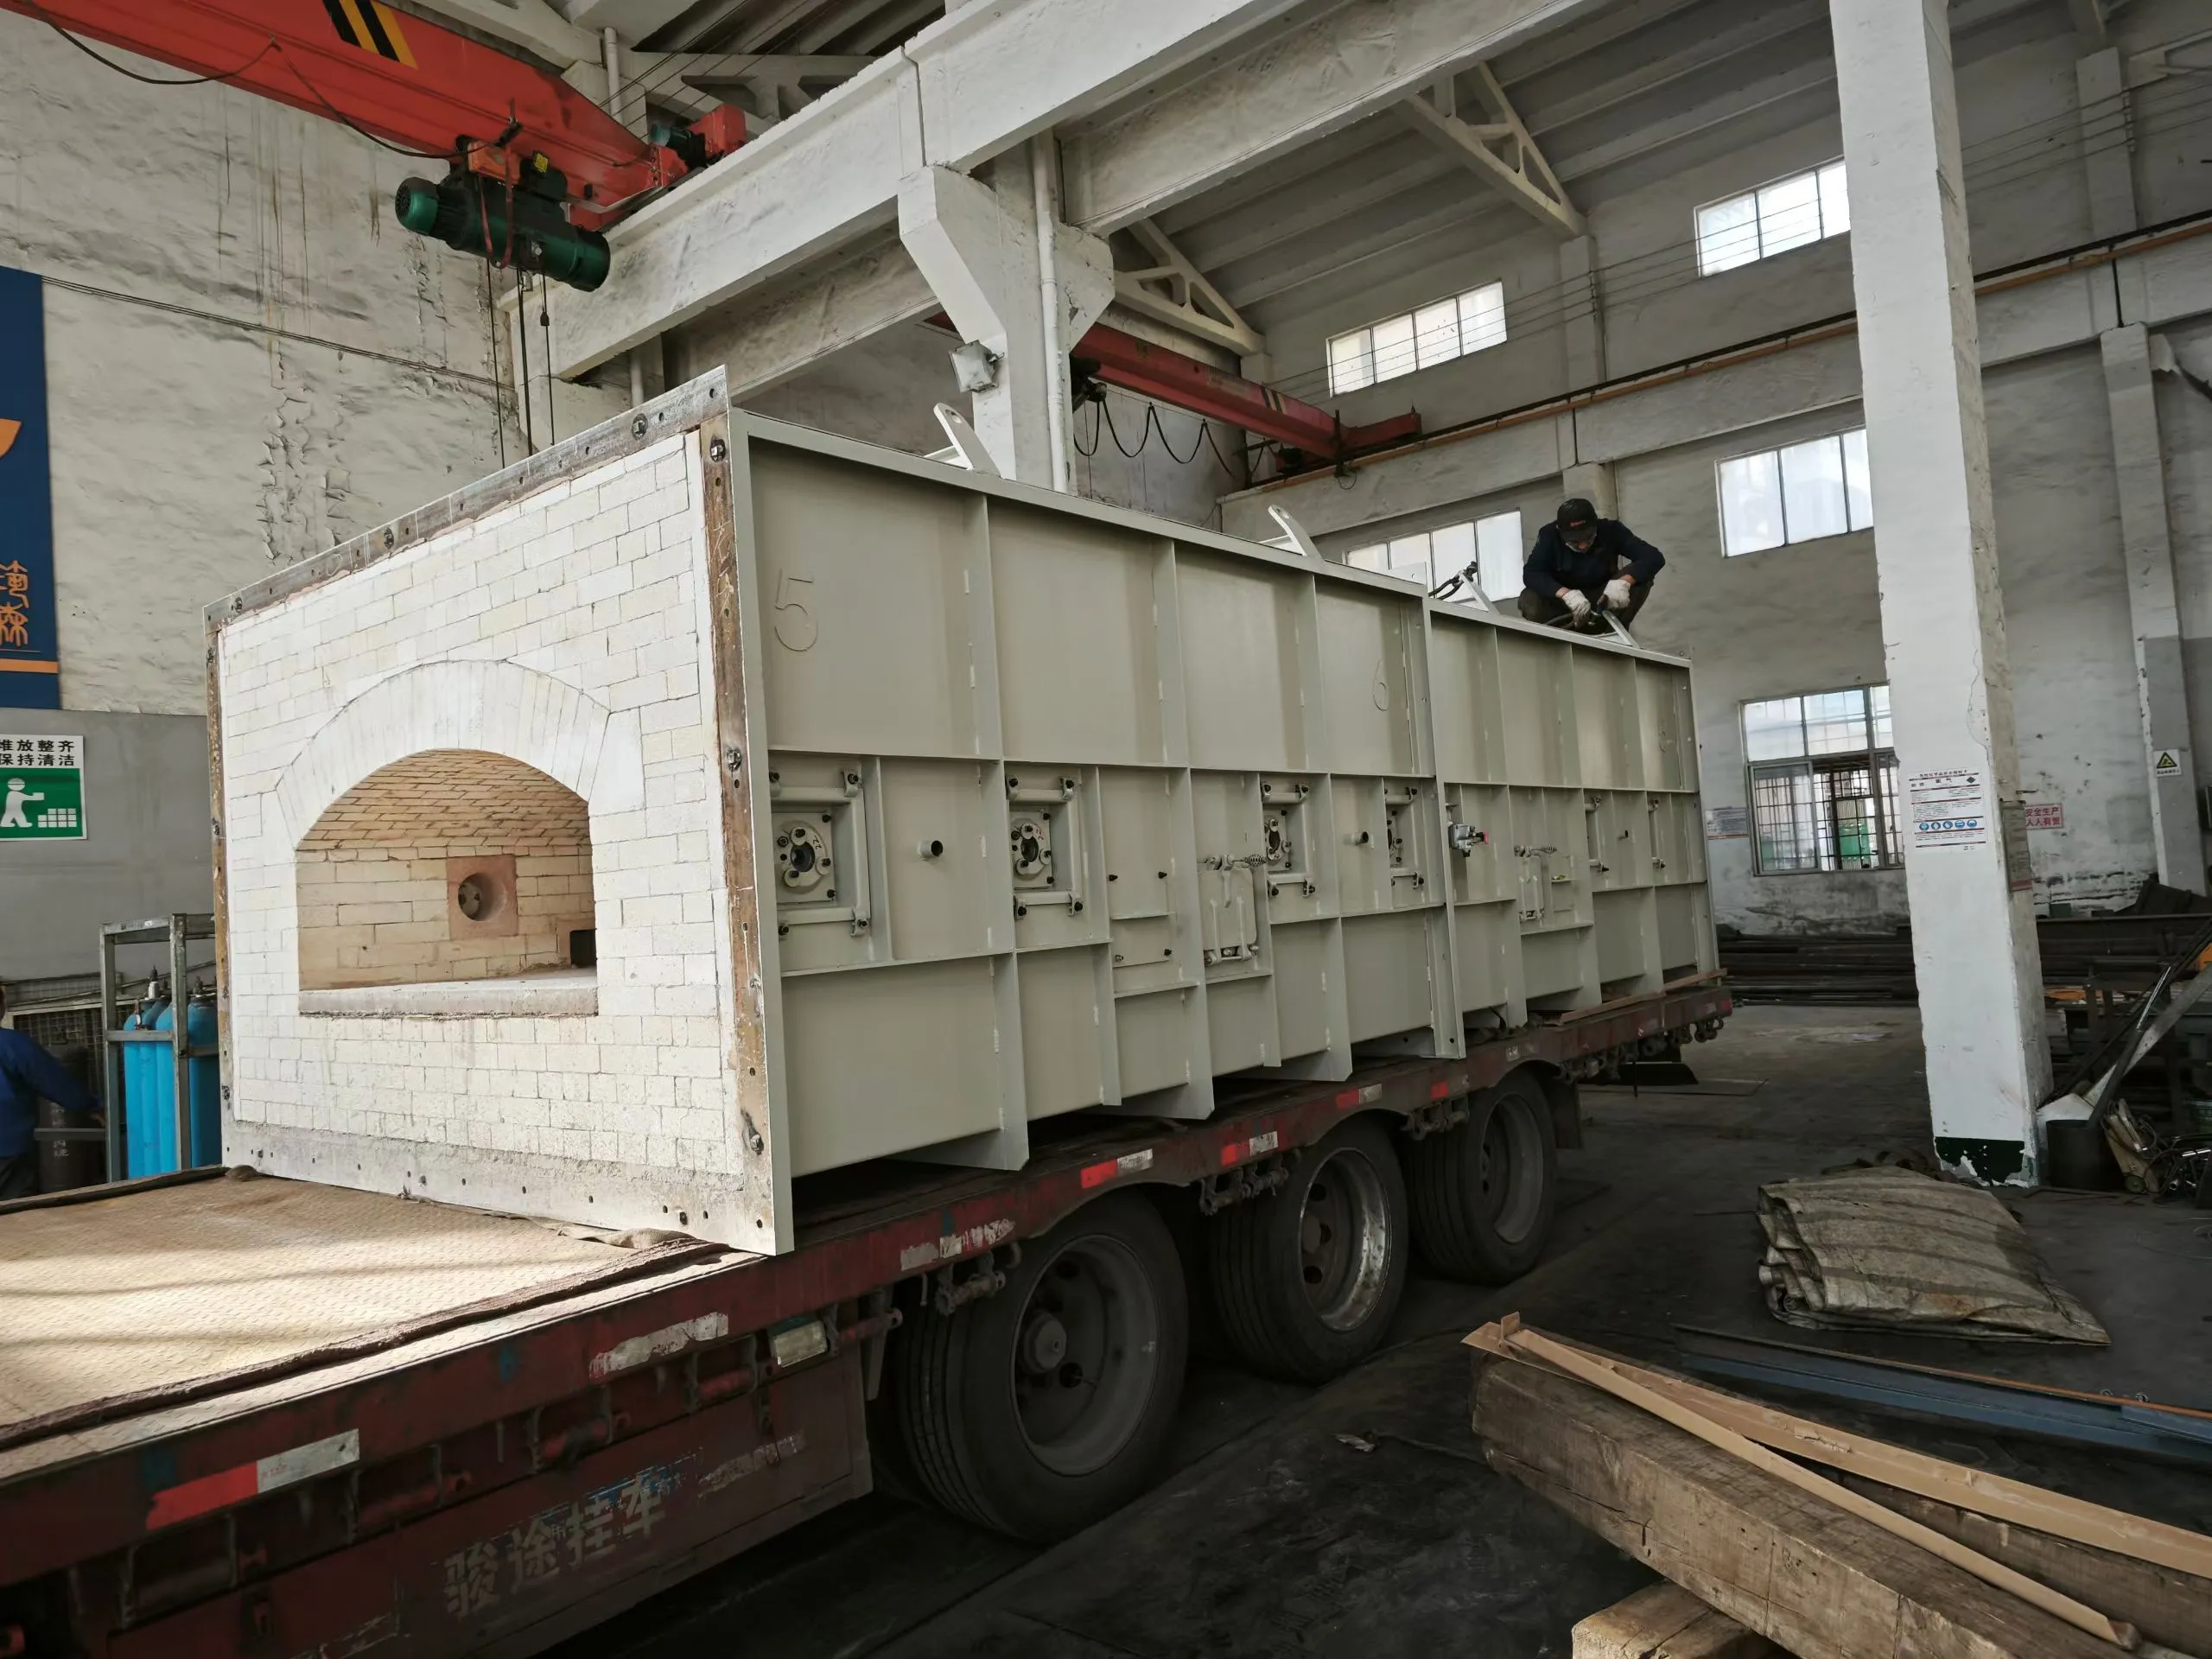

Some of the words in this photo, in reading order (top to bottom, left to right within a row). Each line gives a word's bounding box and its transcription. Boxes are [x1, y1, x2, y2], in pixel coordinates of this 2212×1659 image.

[774, 569, 819, 652] 5
[0, 739, 75, 753] 堆放整齐
[0, 753, 75, 766] 保持清洁
